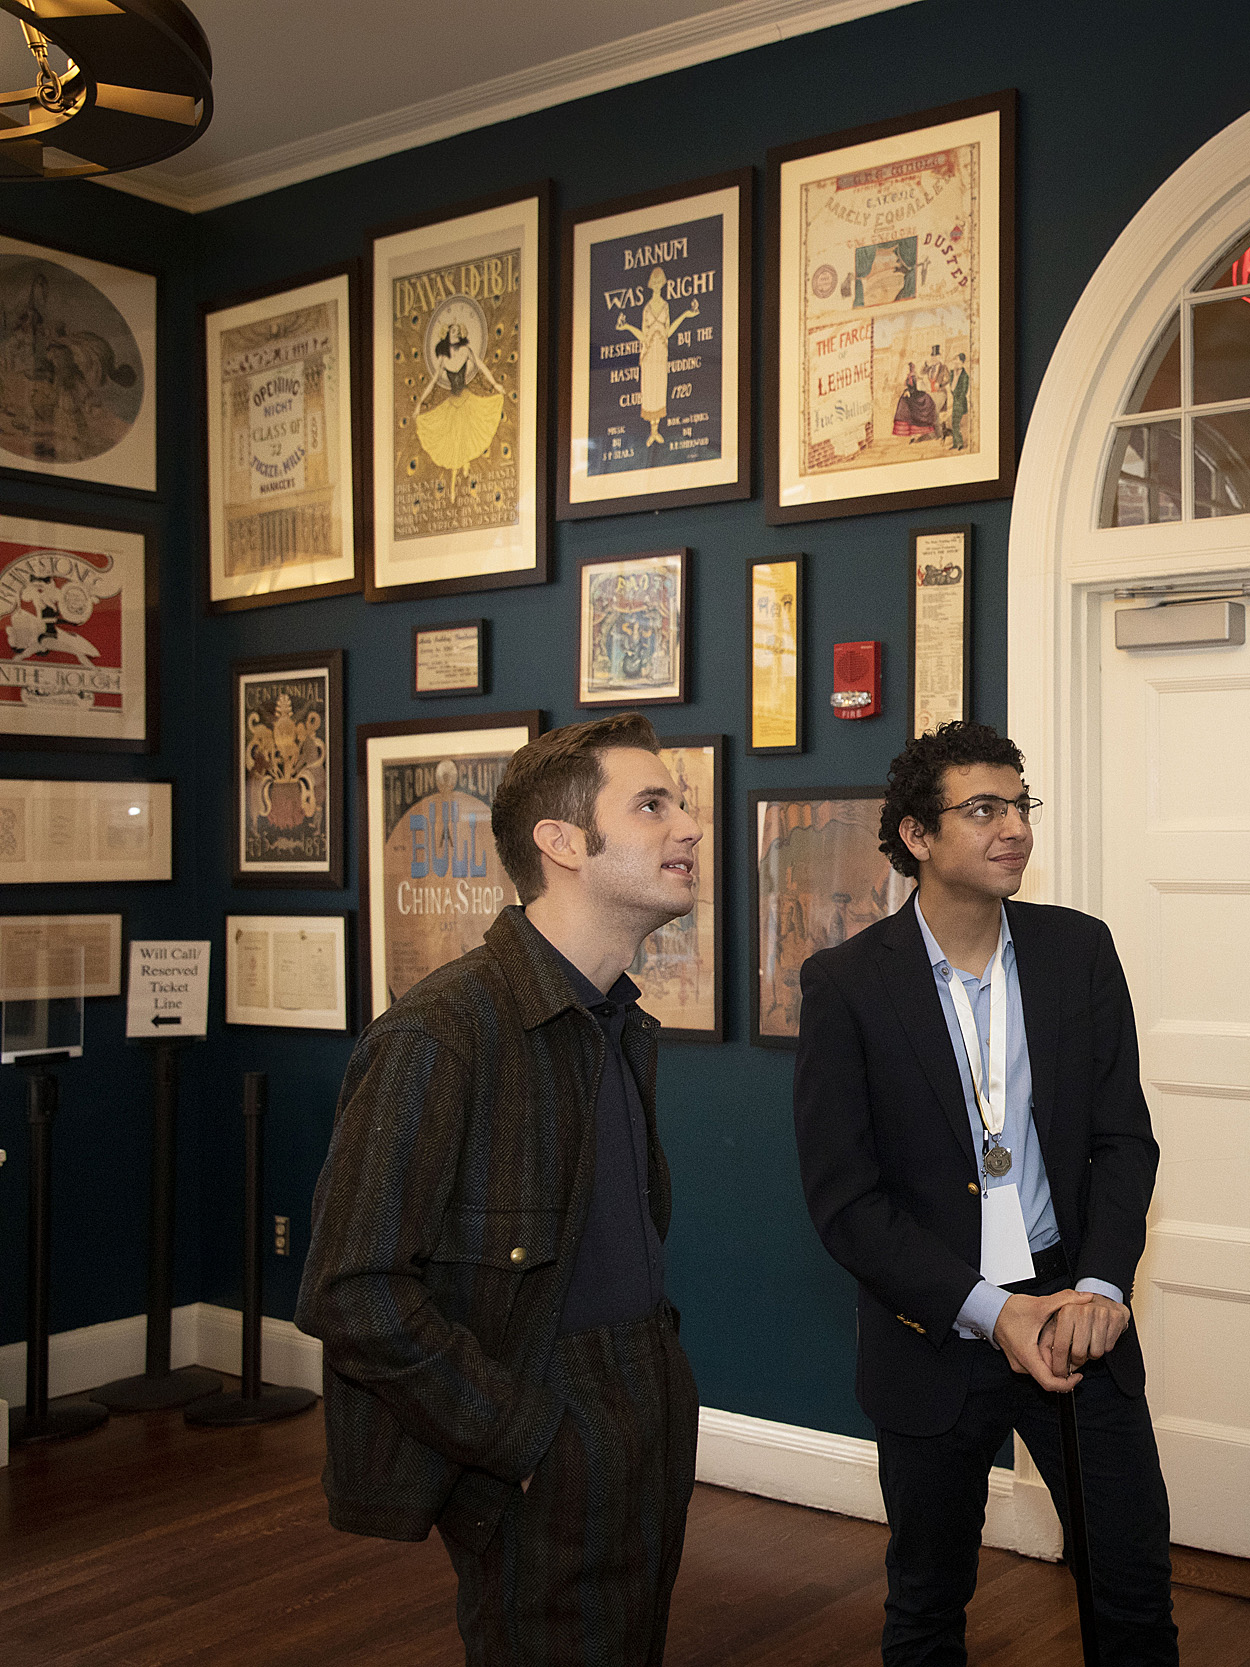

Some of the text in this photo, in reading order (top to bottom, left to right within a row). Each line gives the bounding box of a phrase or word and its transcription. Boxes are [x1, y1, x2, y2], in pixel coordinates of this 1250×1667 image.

[624, 237, 688, 270] BARNUM
[924, 233, 968, 287] DUSTED
[603, 270, 716, 311] WAS RIGHT
[677, 330, 692, 348] BY
[697, 326, 713, 342] THE
[816, 323, 871, 357] THE FARCE
[610, 356, 702, 384] HASTY PUDDING
[253, 375, 301, 408] OPENING
[252, 424, 287, 443] CLASS
[290, 419, 303, 435] OF
[246, 682, 324, 706] CENTENNIAL
[842, 709, 862, 719] FIRE
[409, 801, 487, 879] BULL
[397, 879, 504, 915] CHINA SHOP
[140, 947, 168, 960] Will
[141, 965, 199, 977] Reserved
[150, 981, 189, 993] Ticket
[154, 998, 183, 1010] Line
